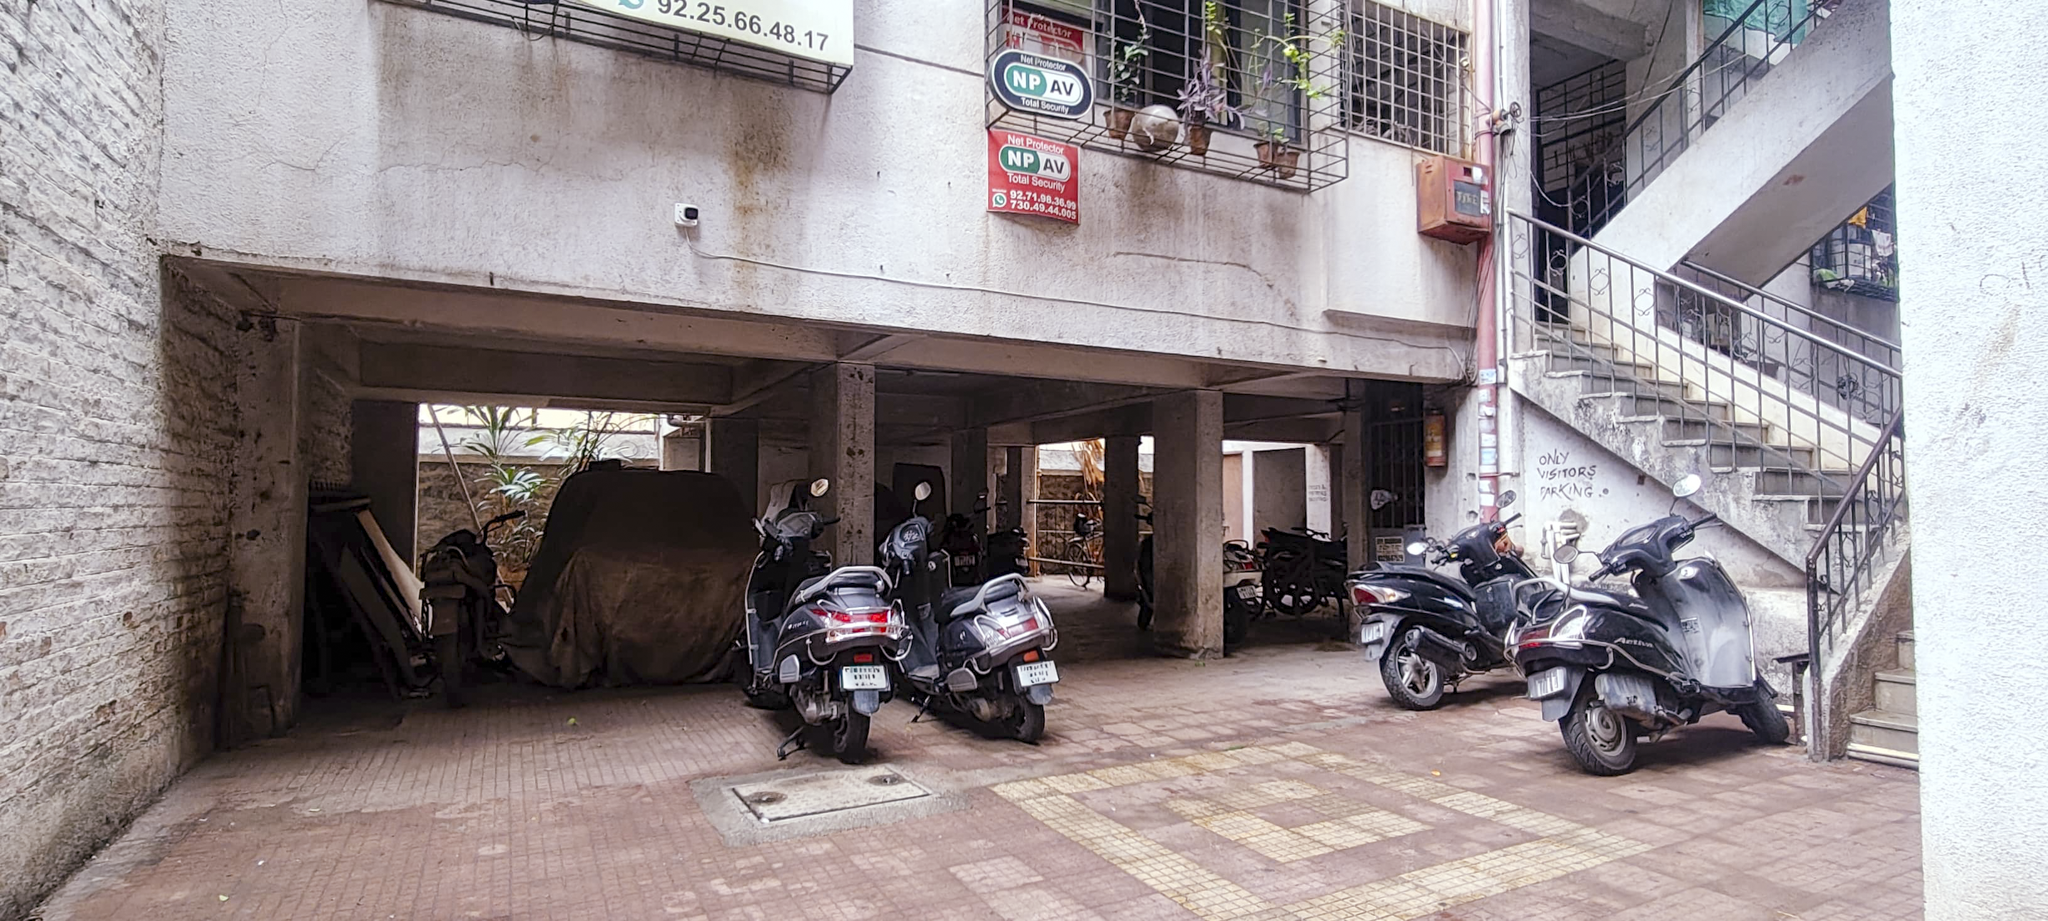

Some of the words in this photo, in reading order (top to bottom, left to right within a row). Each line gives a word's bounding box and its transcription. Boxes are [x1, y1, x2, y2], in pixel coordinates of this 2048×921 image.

[658, 0, 829, 51] 92.25.66.48.17
[1020, 54, 1034, 65] Net
[1035, 59, 1067, 71] Protector
[1013, 70, 1041, 91] NP
[1050, 79, 1074, 97] AV
[1021, 97, 1040, 108] Total
[1041, 101, 1069, 115] Security
[1007, 134, 1024, 146] Net
[1026, 138, 1064, 155] Protector
[1008, 150, 1035, 168] NP
[1043, 158, 1065, 174] AV
[1007, 173, 1030, 184] Total
[1032, 176, 1066, 193] Security
[1010, 200, 1077, 220] 730.49.44.005
[1539, 448, 1570, 466] ONLY
[1536, 465, 1597, 480] VISITORS
